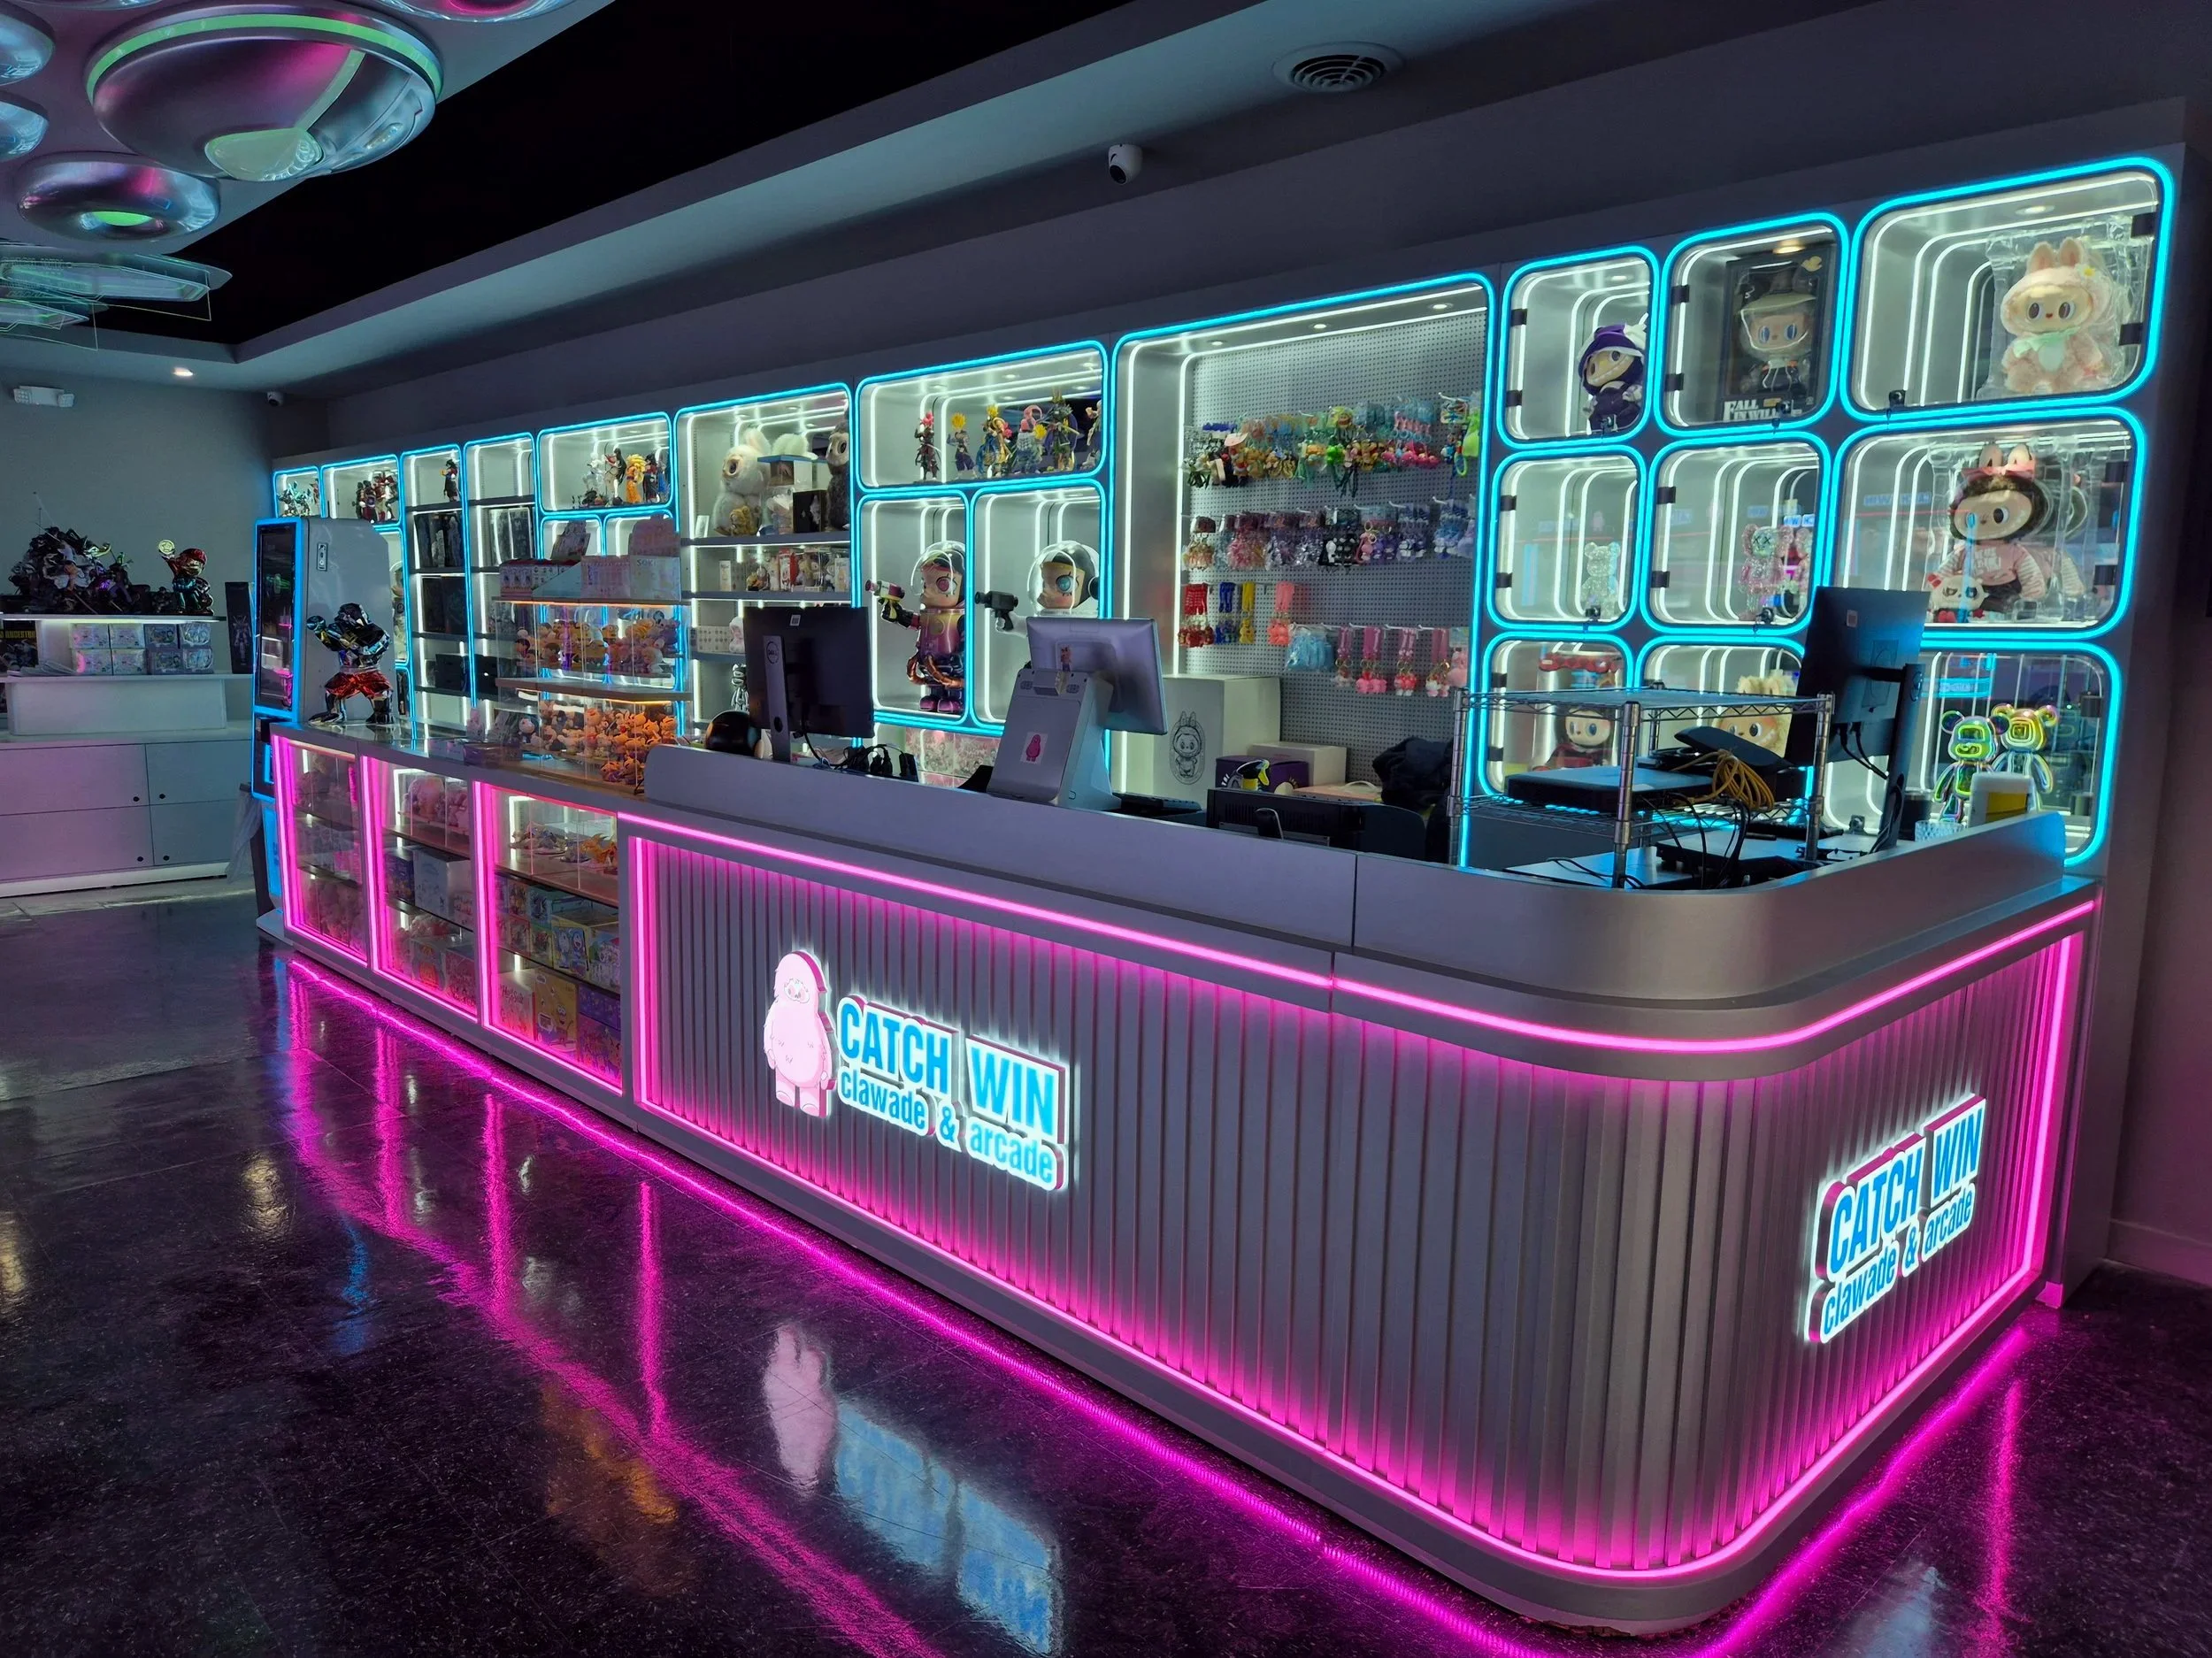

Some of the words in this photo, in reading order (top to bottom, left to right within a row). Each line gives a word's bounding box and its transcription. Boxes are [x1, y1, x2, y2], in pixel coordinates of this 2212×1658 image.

[841, 1002, 949, 1094] CATCH
[971, 1047, 1056, 1136] WIN
[841, 1068, 926, 1131] clawade
[939, 1106, 958, 1143] &
[970, 1118, 1053, 1184] arcade
[1831, 1147, 1924, 1274] CATCH
[1933, 1107, 1984, 1199] WIN
[1824, 1246, 1897, 1336] clawade
[1905, 1225, 1918, 1267] &
[1924, 1187, 1973, 1254] arcade
